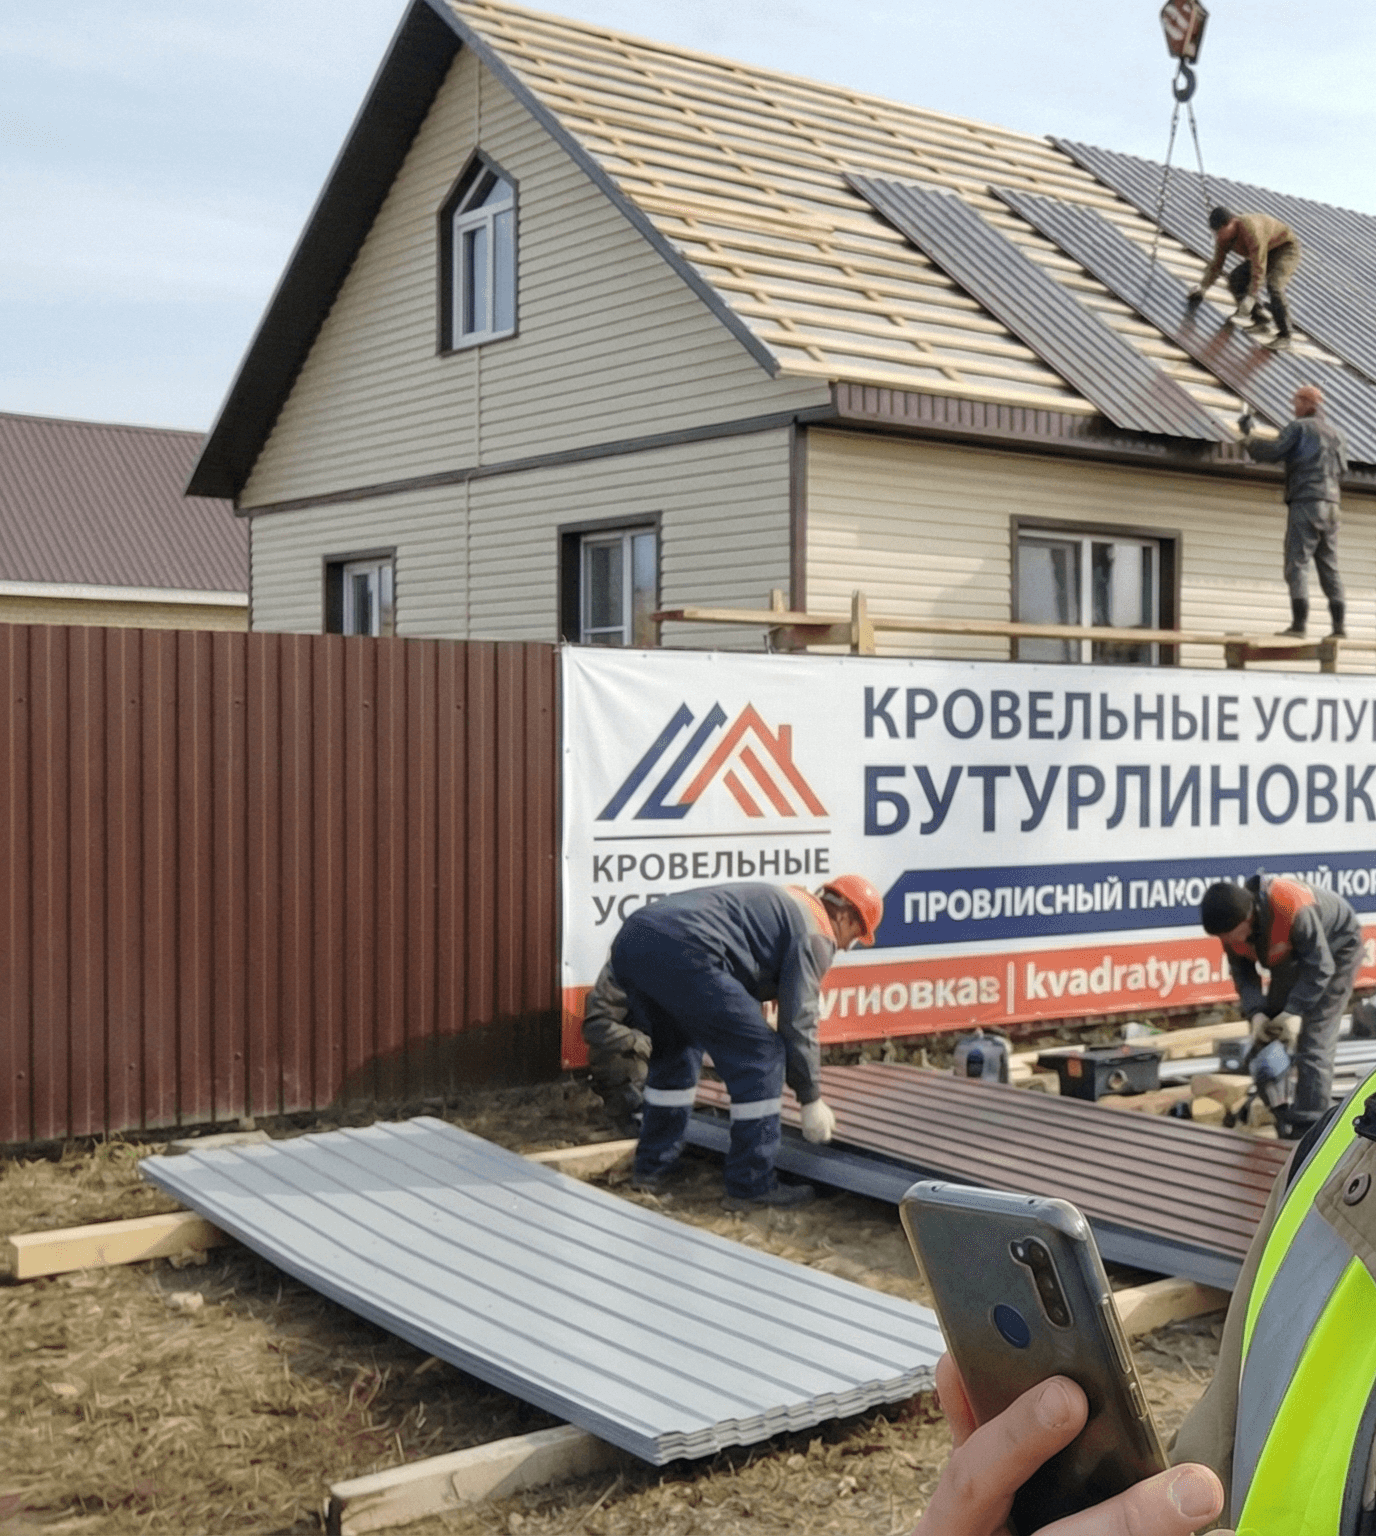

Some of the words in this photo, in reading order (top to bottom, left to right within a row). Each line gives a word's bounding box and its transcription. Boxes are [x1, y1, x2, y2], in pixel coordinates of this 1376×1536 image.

[863, 686, 1240, 741] КРОВЕЛЬНЫЕ
[592, 847, 830, 883] КРОВЕЛЬНЫЕ
[903, 875, 1123, 924] ПРОВЛИСНЫЙ
